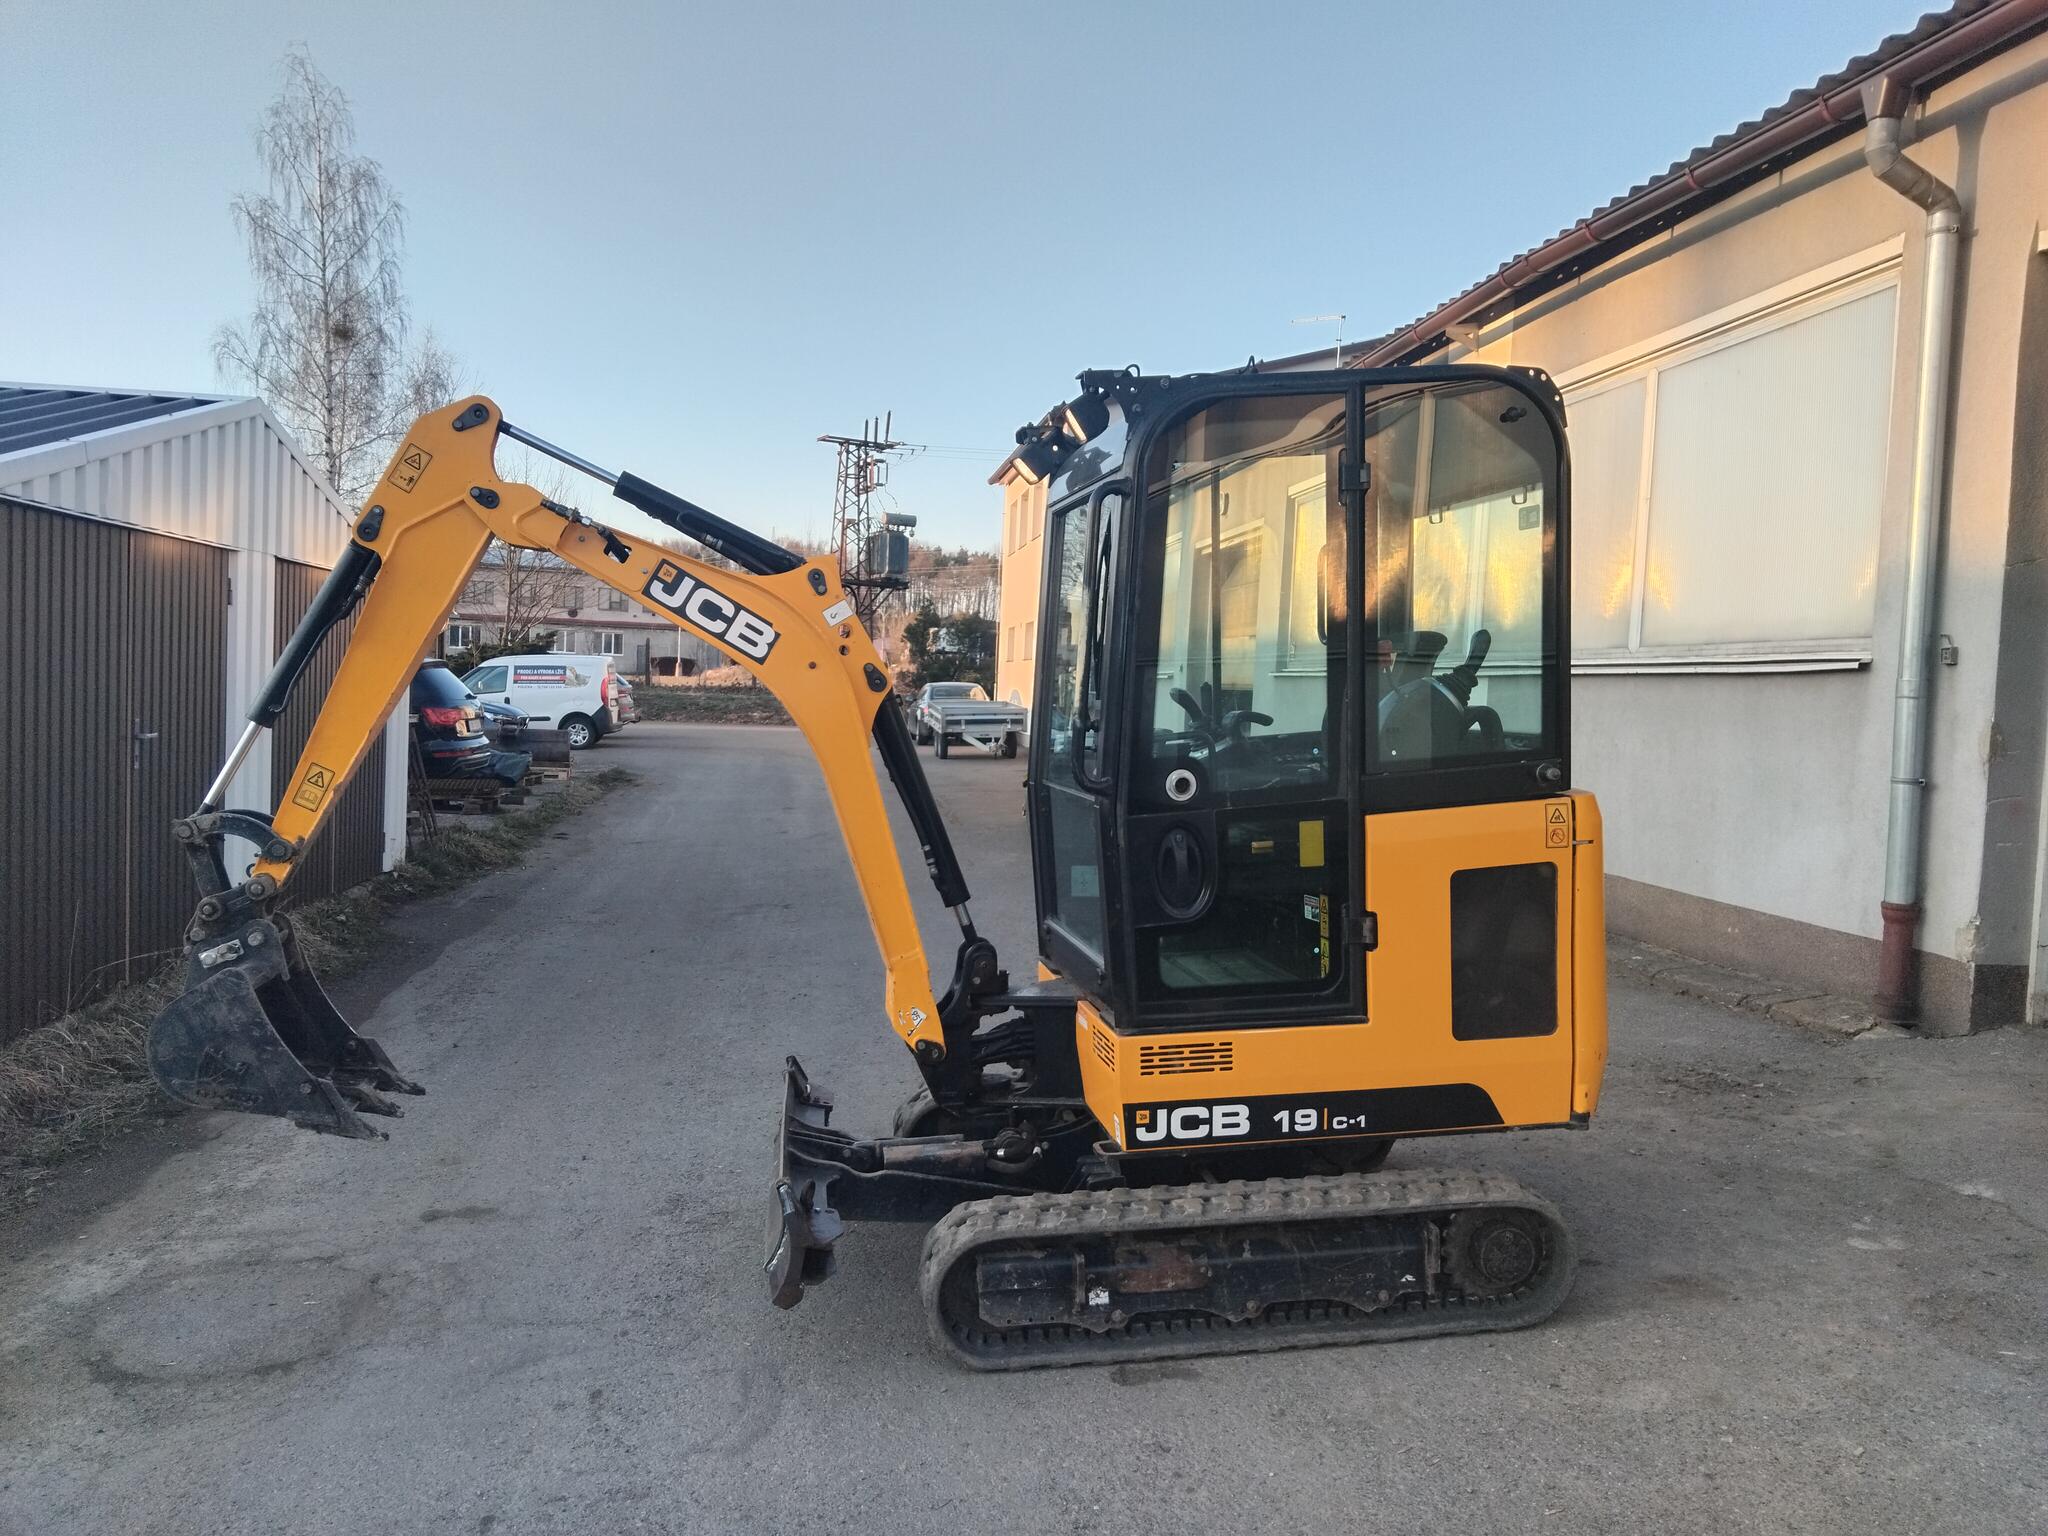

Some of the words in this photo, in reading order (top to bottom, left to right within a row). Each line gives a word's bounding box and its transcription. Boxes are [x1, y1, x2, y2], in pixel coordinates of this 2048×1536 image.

[650, 576, 776, 658] JCB
[1135, 1104, 1250, 1142] JCB
[1273, 1108, 1318, 1133] 19
